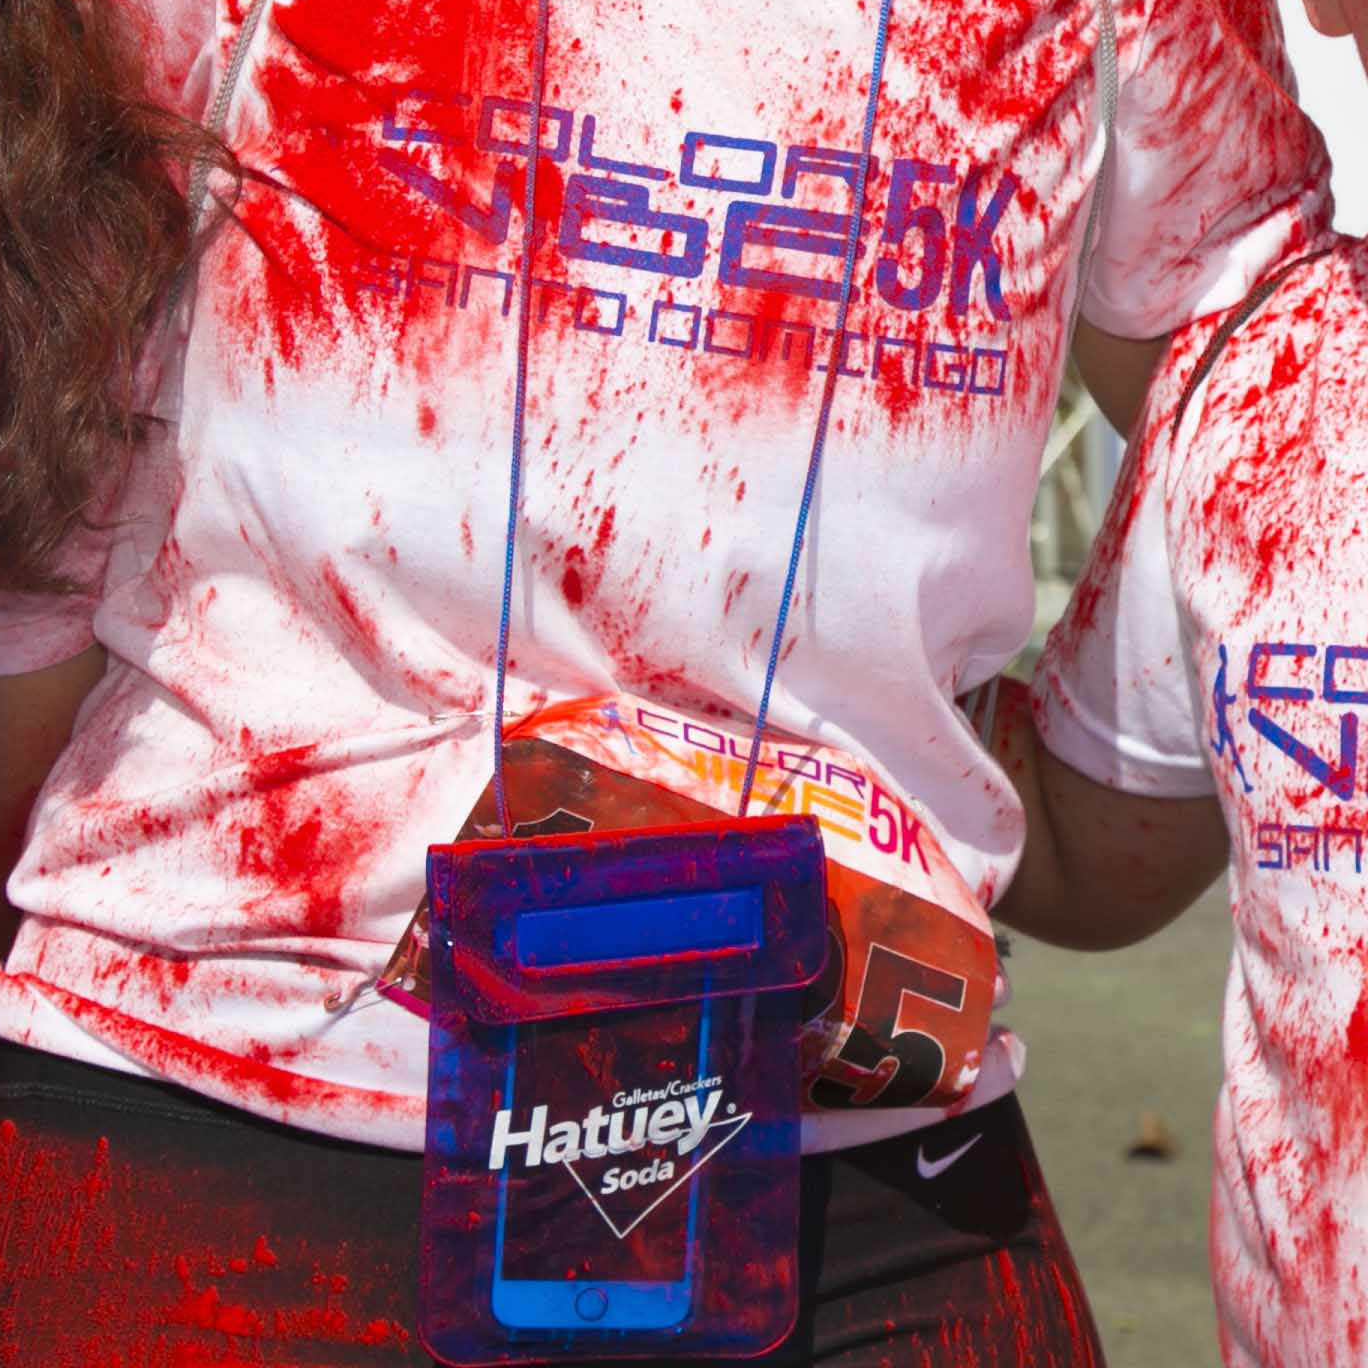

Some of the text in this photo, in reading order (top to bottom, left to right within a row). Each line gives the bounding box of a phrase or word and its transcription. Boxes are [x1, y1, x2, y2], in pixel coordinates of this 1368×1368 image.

[377, 147, 1019, 322] VBE 5K
[648, 300, 1007, 395] DOMINGO
[636, 707, 867, 799] COLOR
[868, 782, 931, 875] 5K
[488, 1090, 723, 1170] Hatuey
[612, 1075, 723, 1109] Galletas/Crackers
[600, 1158, 675, 1195] Soda
